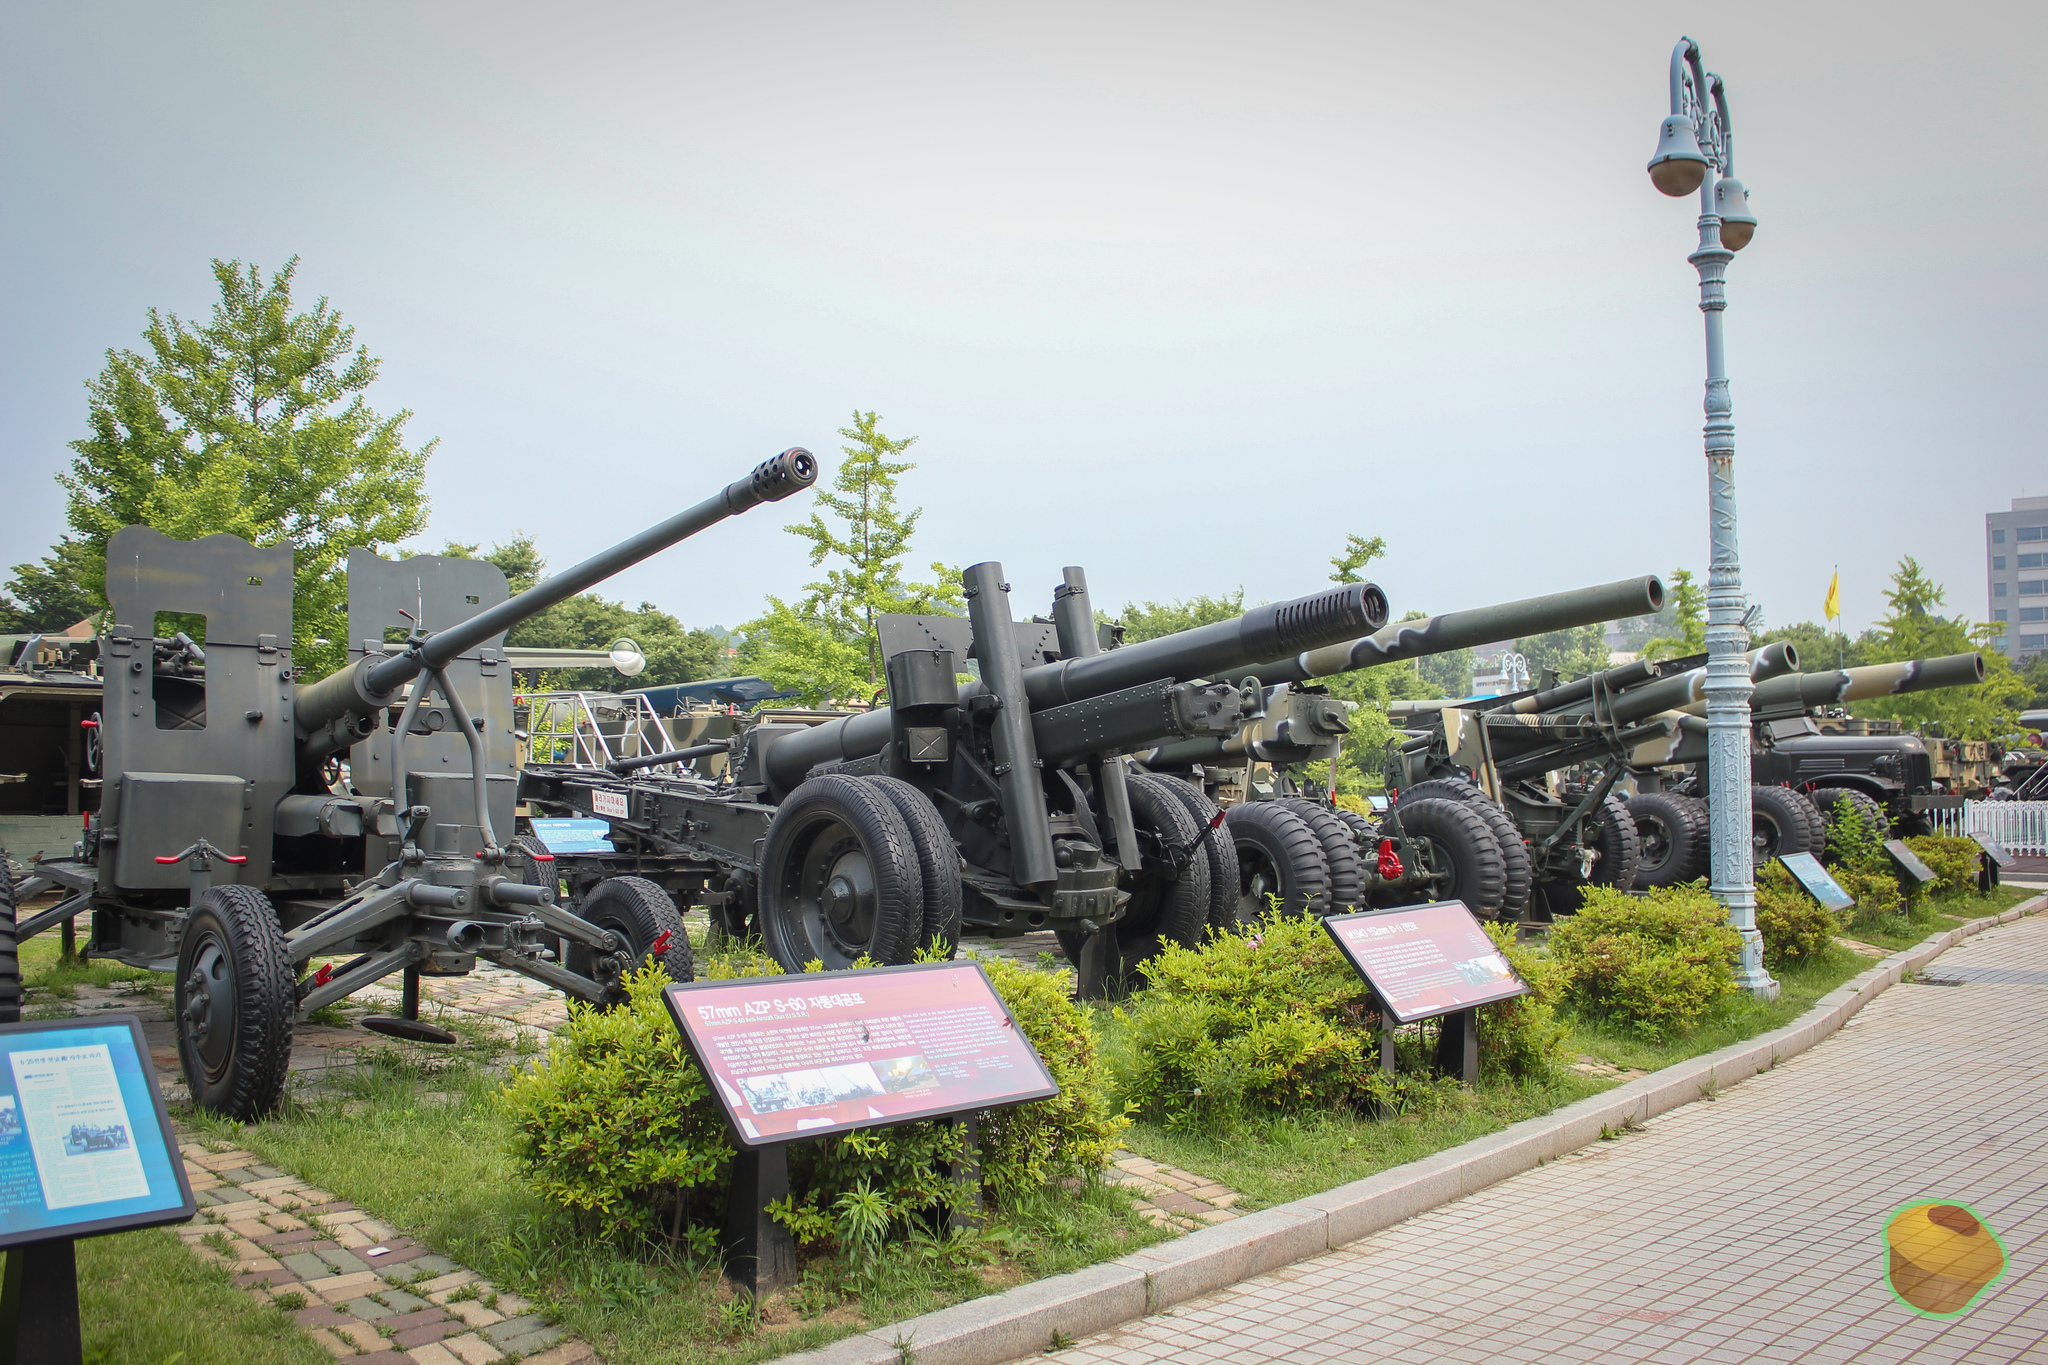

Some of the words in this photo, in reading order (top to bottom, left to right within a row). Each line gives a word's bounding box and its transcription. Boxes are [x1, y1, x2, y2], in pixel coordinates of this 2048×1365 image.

[1345, 928, 1369, 939] M1943
[1367, 926, 1390, 937] 152mm
[697, 1006, 741, 1020] 57mm
[745, 1001, 771, 1015] AZP
[774, 998, 807, 1012] S-60
[807, 992, 865, 1009] 자동대공포
